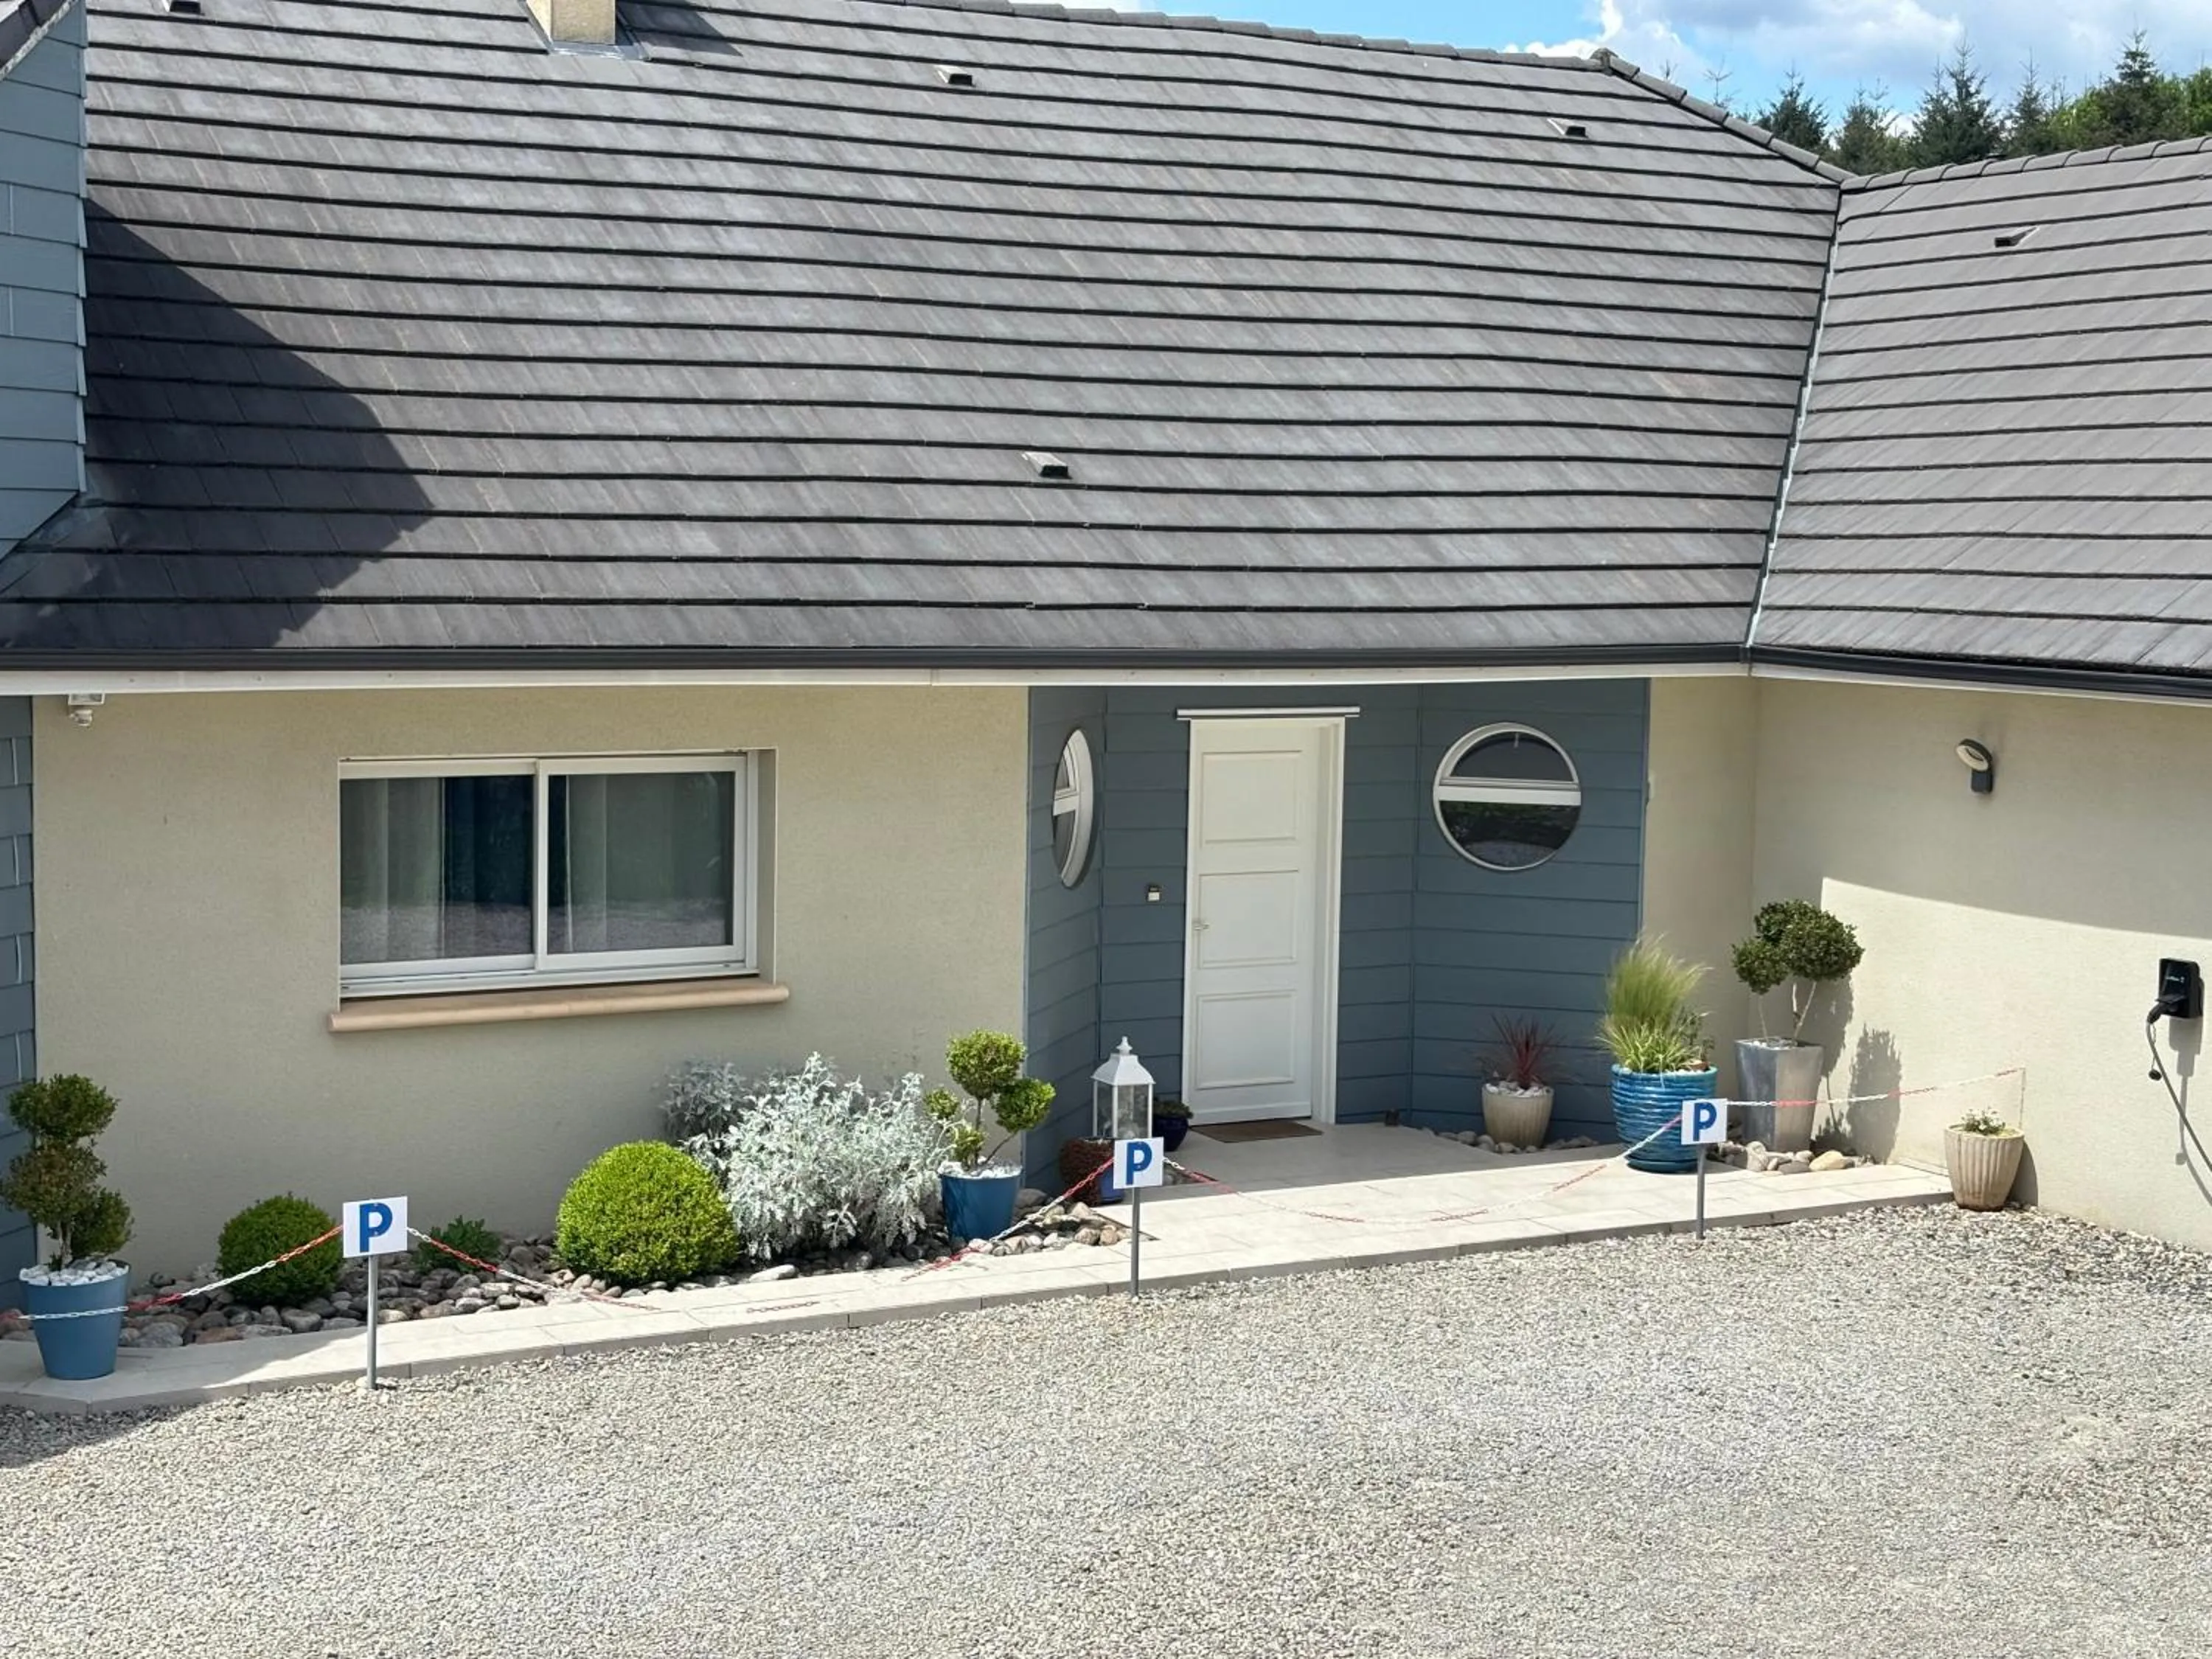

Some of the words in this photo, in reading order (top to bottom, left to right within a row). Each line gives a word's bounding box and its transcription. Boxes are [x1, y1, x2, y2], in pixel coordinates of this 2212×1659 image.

[1693, 1102, 1717, 1141] P
[1126, 1141, 1152, 1185] P
[359, 1203, 393, 1253] P
